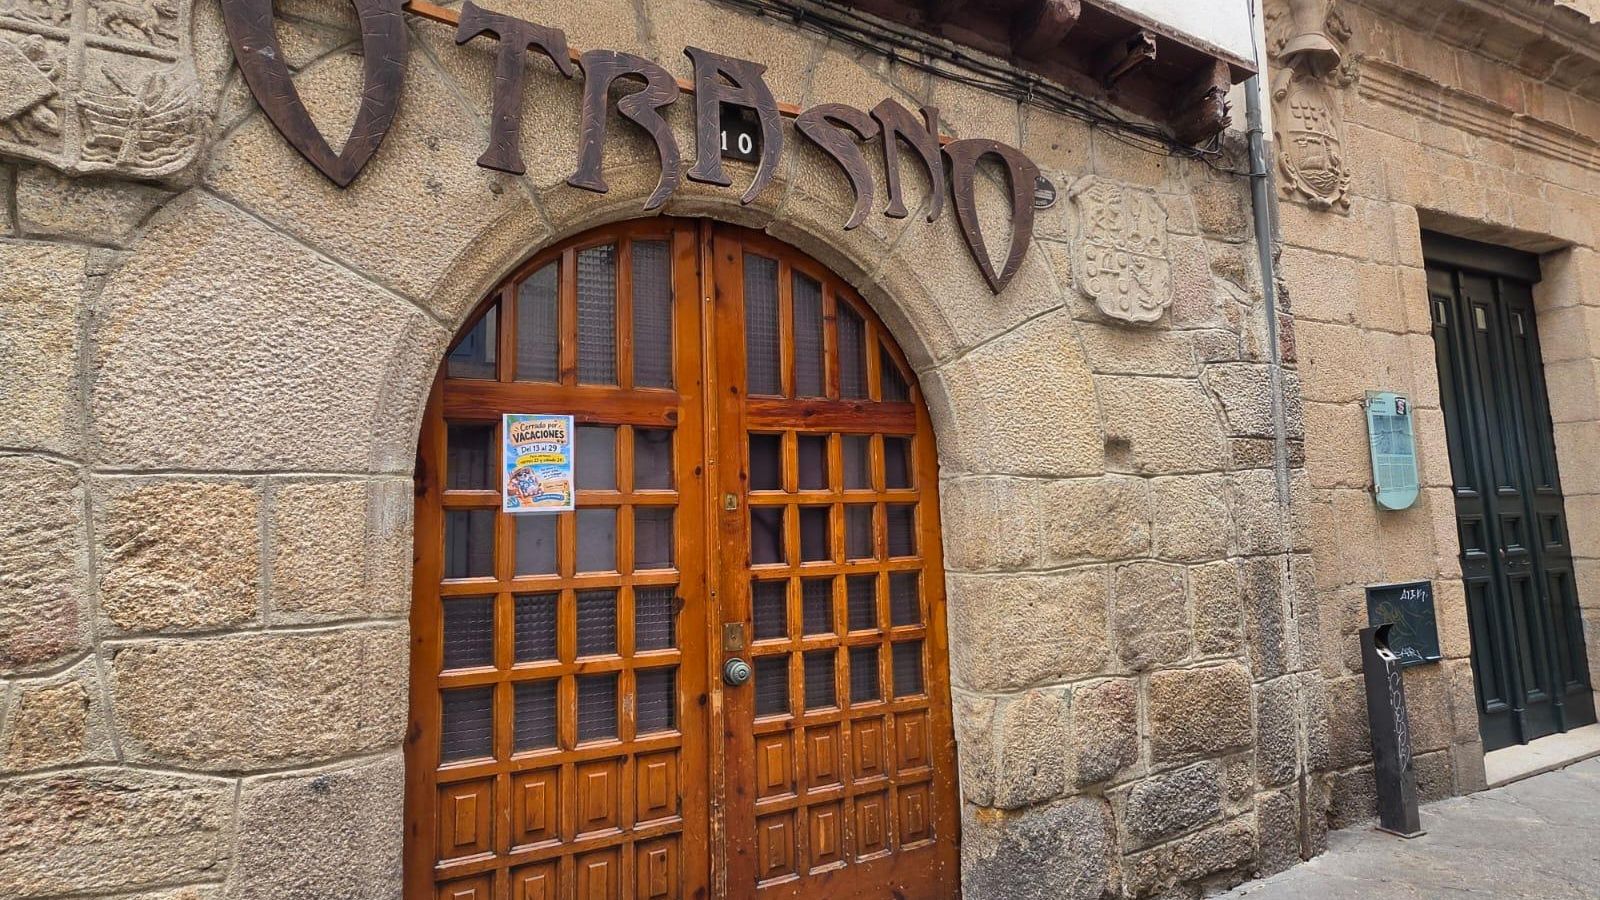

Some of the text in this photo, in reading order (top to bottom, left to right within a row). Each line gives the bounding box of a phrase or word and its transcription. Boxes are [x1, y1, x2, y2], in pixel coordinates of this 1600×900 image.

[455, 1, 1039, 294] TRASNO
[721, 130, 752, 154] 10
[520, 422, 546, 431] Cerrado
[512, 430, 564, 443] VACACIONES
